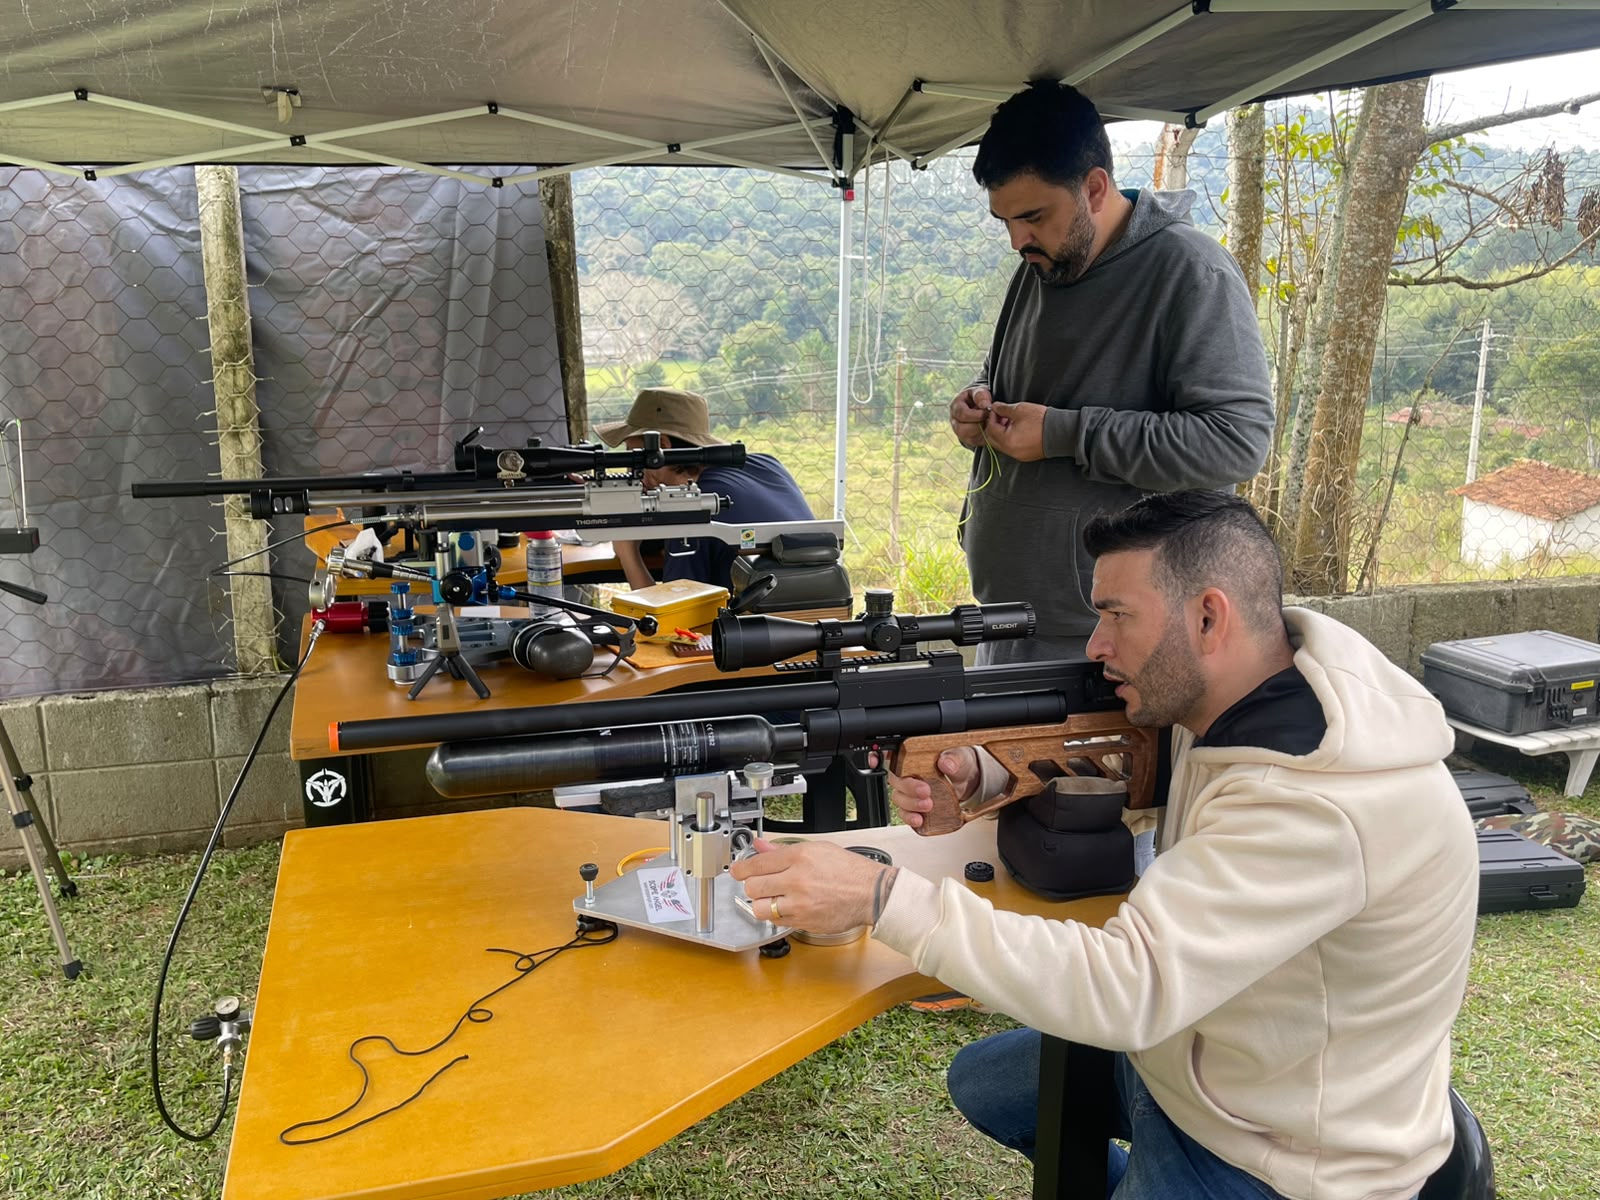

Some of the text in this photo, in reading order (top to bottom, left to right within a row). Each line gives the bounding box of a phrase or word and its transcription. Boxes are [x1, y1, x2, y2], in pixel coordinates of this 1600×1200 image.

[575, 518, 608, 526] THOMAS
[991, 622, 1018, 630] ELEMENT
[648, 880, 659, 896] SCOPE
[653, 895, 663, 912] ANGEL
